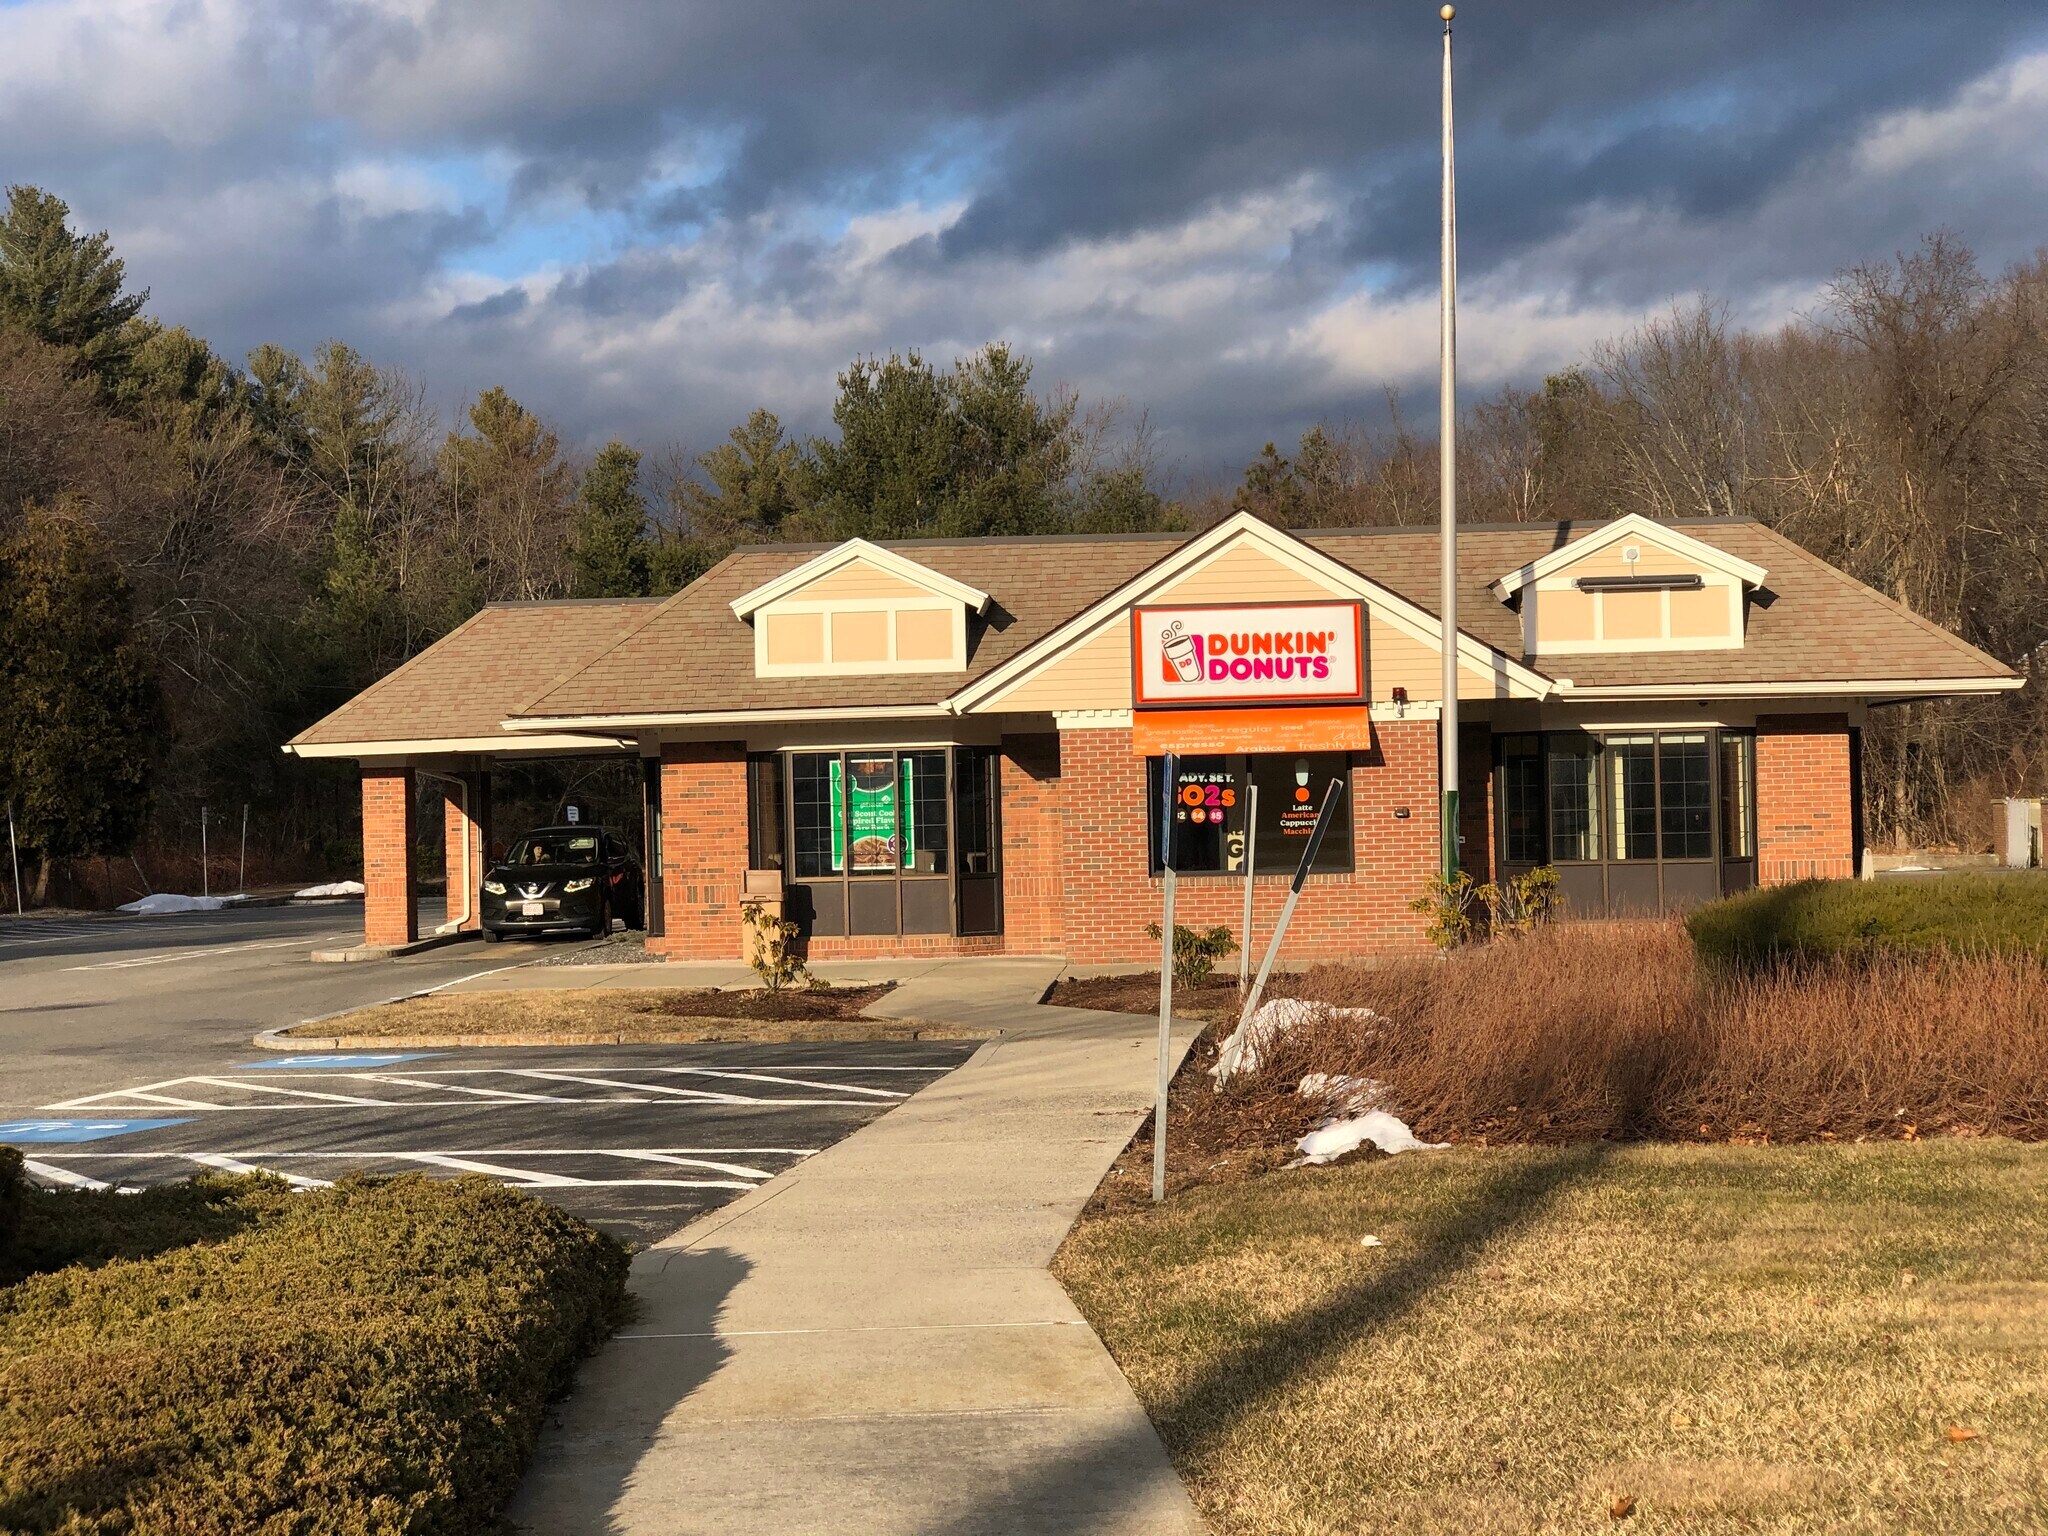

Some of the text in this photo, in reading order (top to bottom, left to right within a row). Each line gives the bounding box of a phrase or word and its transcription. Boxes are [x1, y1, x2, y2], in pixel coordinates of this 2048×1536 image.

[1208, 631, 1335, 656] DUNKIN'
[1179, 658, 1192, 668] DD
[1208, 656, 1329, 681] DONUTS
[1146, 728, 1203, 737] great tasting
[1228, 726, 1273, 735] regular
[1160, 742, 1225, 750] espresso
[1235, 744, 1286, 753] Arabica
[1299, 740, 1346, 751] freshly
[1208, 772, 1235, 783] SET.
[1292, 804, 1314, 812] Latte
[1191, 811, 1205, 820] $4
[1210, 811, 1223, 820] $5
[1279, 818, 1317, 828] Cappucci
[1283, 827, 1314, 835] Macchi
